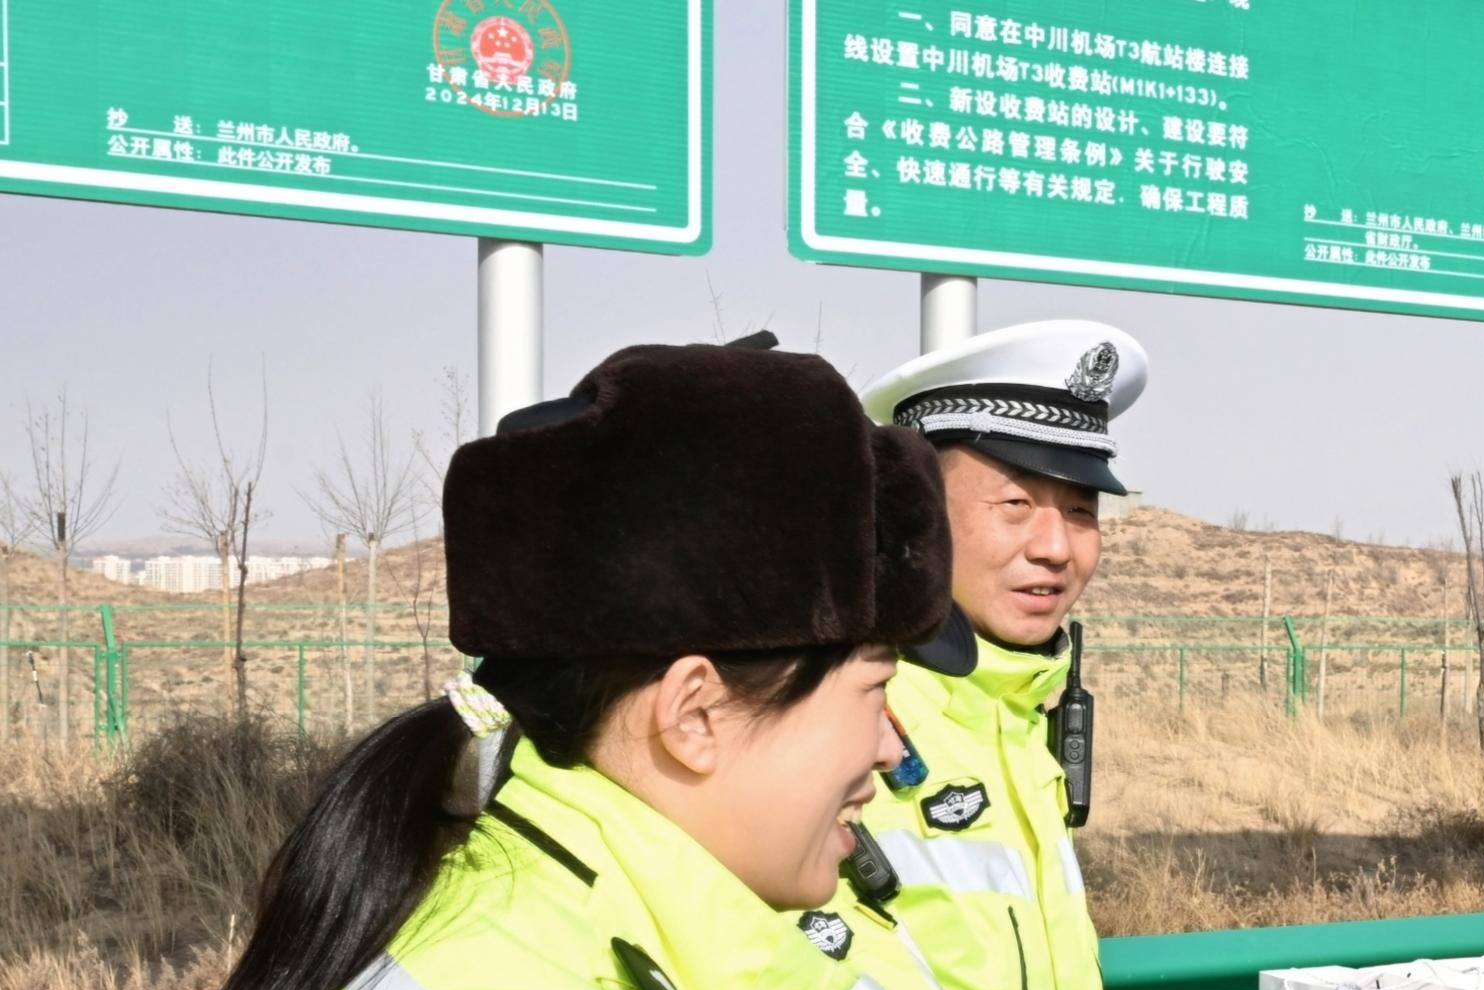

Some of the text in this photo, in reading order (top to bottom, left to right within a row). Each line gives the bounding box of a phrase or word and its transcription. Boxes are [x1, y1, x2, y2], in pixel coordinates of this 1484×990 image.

[898, 11, 1249, 79] 一、同意在中川机场T3航站楼连接
[426, 63, 578, 100] 甘肃省人民政府
[425, 87, 578, 121] 2024年12月13日
[898, 81, 1248, 150] 二、新设收费站的设计、建设要符
[217, 145, 331, 175] 此件公开发布
